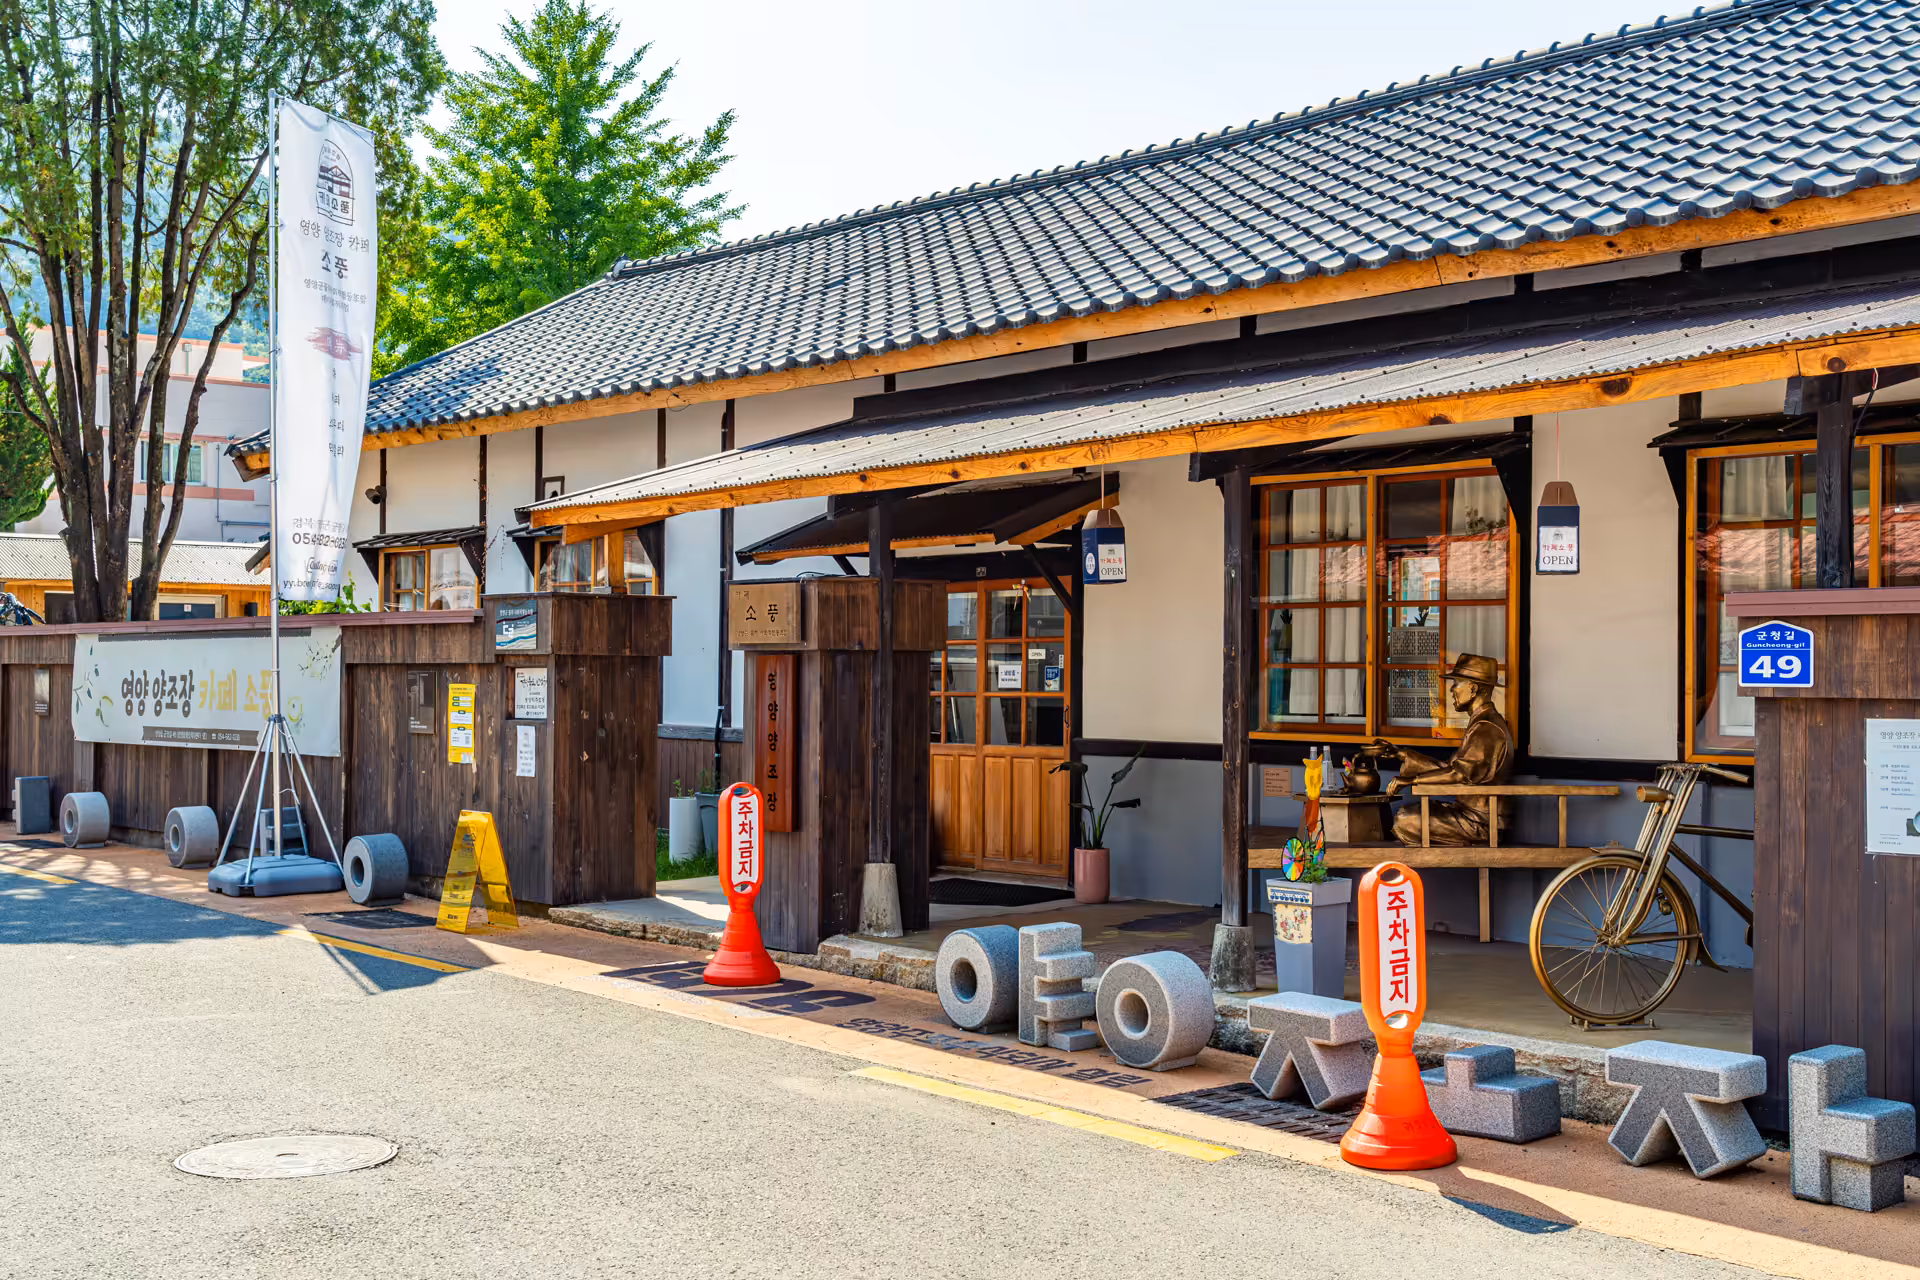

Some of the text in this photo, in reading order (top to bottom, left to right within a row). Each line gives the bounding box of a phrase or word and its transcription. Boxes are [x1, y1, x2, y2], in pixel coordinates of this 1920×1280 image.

[300, 219, 321, 238] 영양
[322, 248, 349, 279] 소풍
[1542, 555, 1574, 565] OPEN
[1100, 567, 1124, 576] OPEN
[745, 604, 779, 622] 소풍
[1756, 630, 1795, 641] 군청길
[1749, 655, 1802, 678] 49
[121, 669, 149, 717] 영양
[152, 669, 195, 718] 양조장
[198, 668, 237, 712] 카페
[767, 671, 779, 813] 영양양조장
[1880, 731, 1894, 739] 영양
[737, 801, 754, 878] 주차금지
[1386, 890, 1411, 1004] 주차금지
